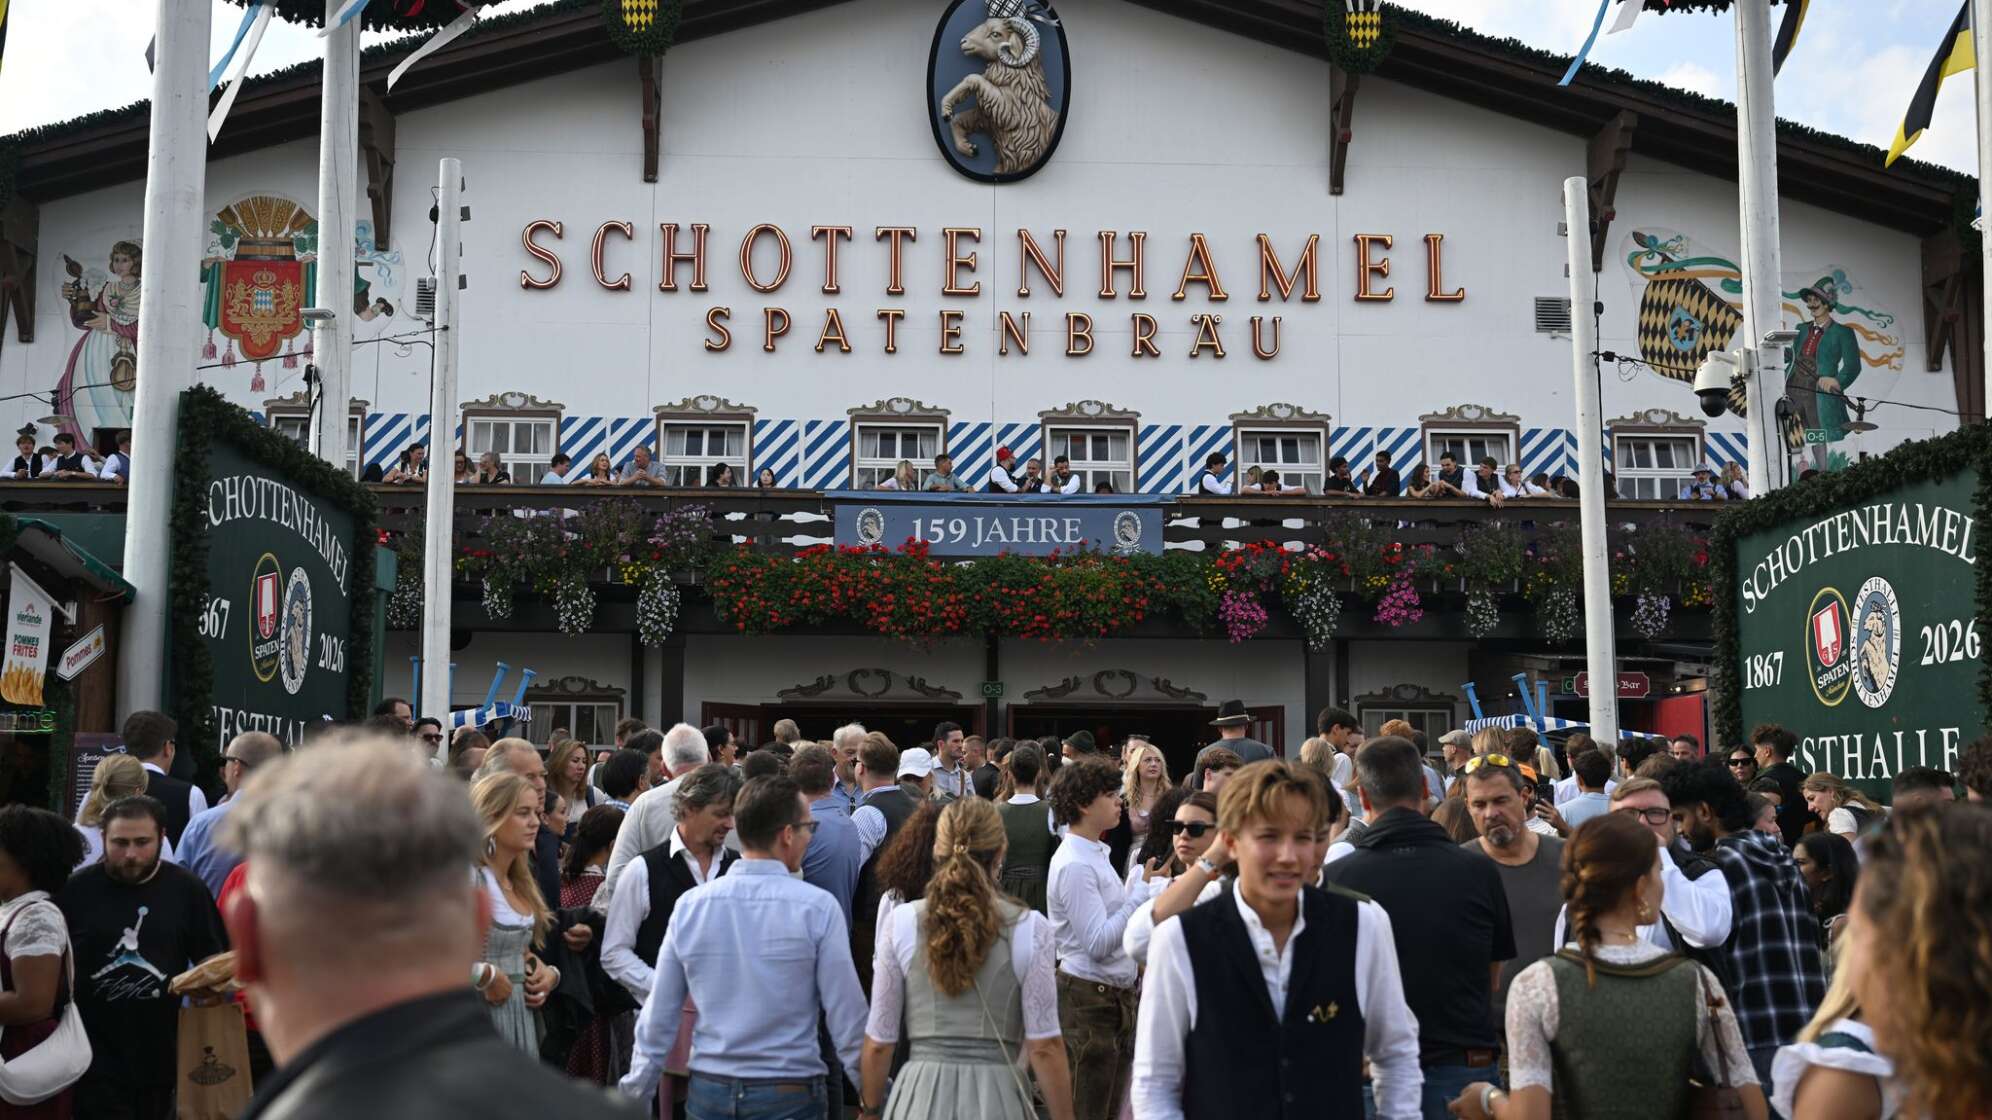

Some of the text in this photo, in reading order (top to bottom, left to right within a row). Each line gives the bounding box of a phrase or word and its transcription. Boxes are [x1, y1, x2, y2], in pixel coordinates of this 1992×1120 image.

[520, 219, 1465, 303] SCHOTTENHAMEL
[704, 306, 1283, 360] SPATENBRÄU
[1807, 432, 1825, 441] O-5
[200, 475, 348, 597] CHOTTENHAMEL
[912, 517, 967, 544] 159
[971, 516, 1084, 547] JAHRE
[1742, 503, 1977, 614] SCHOTTENHAMEL
[12, 645, 38, 659] FRITES
[14, 633, 39, 646] POMMES
[66, 643, 92, 669] Pommes
[255, 638, 281, 660] SPATEN
[319, 632, 345, 673] 2026
[1920, 618, 1981, 667] 2026
[1620, 680, 1640, 689] Bar
[1744, 651, 1784, 689] 1867
[1817, 660, 1850, 689] SPATEN
[1787, 727, 1961, 780] STHALLE
